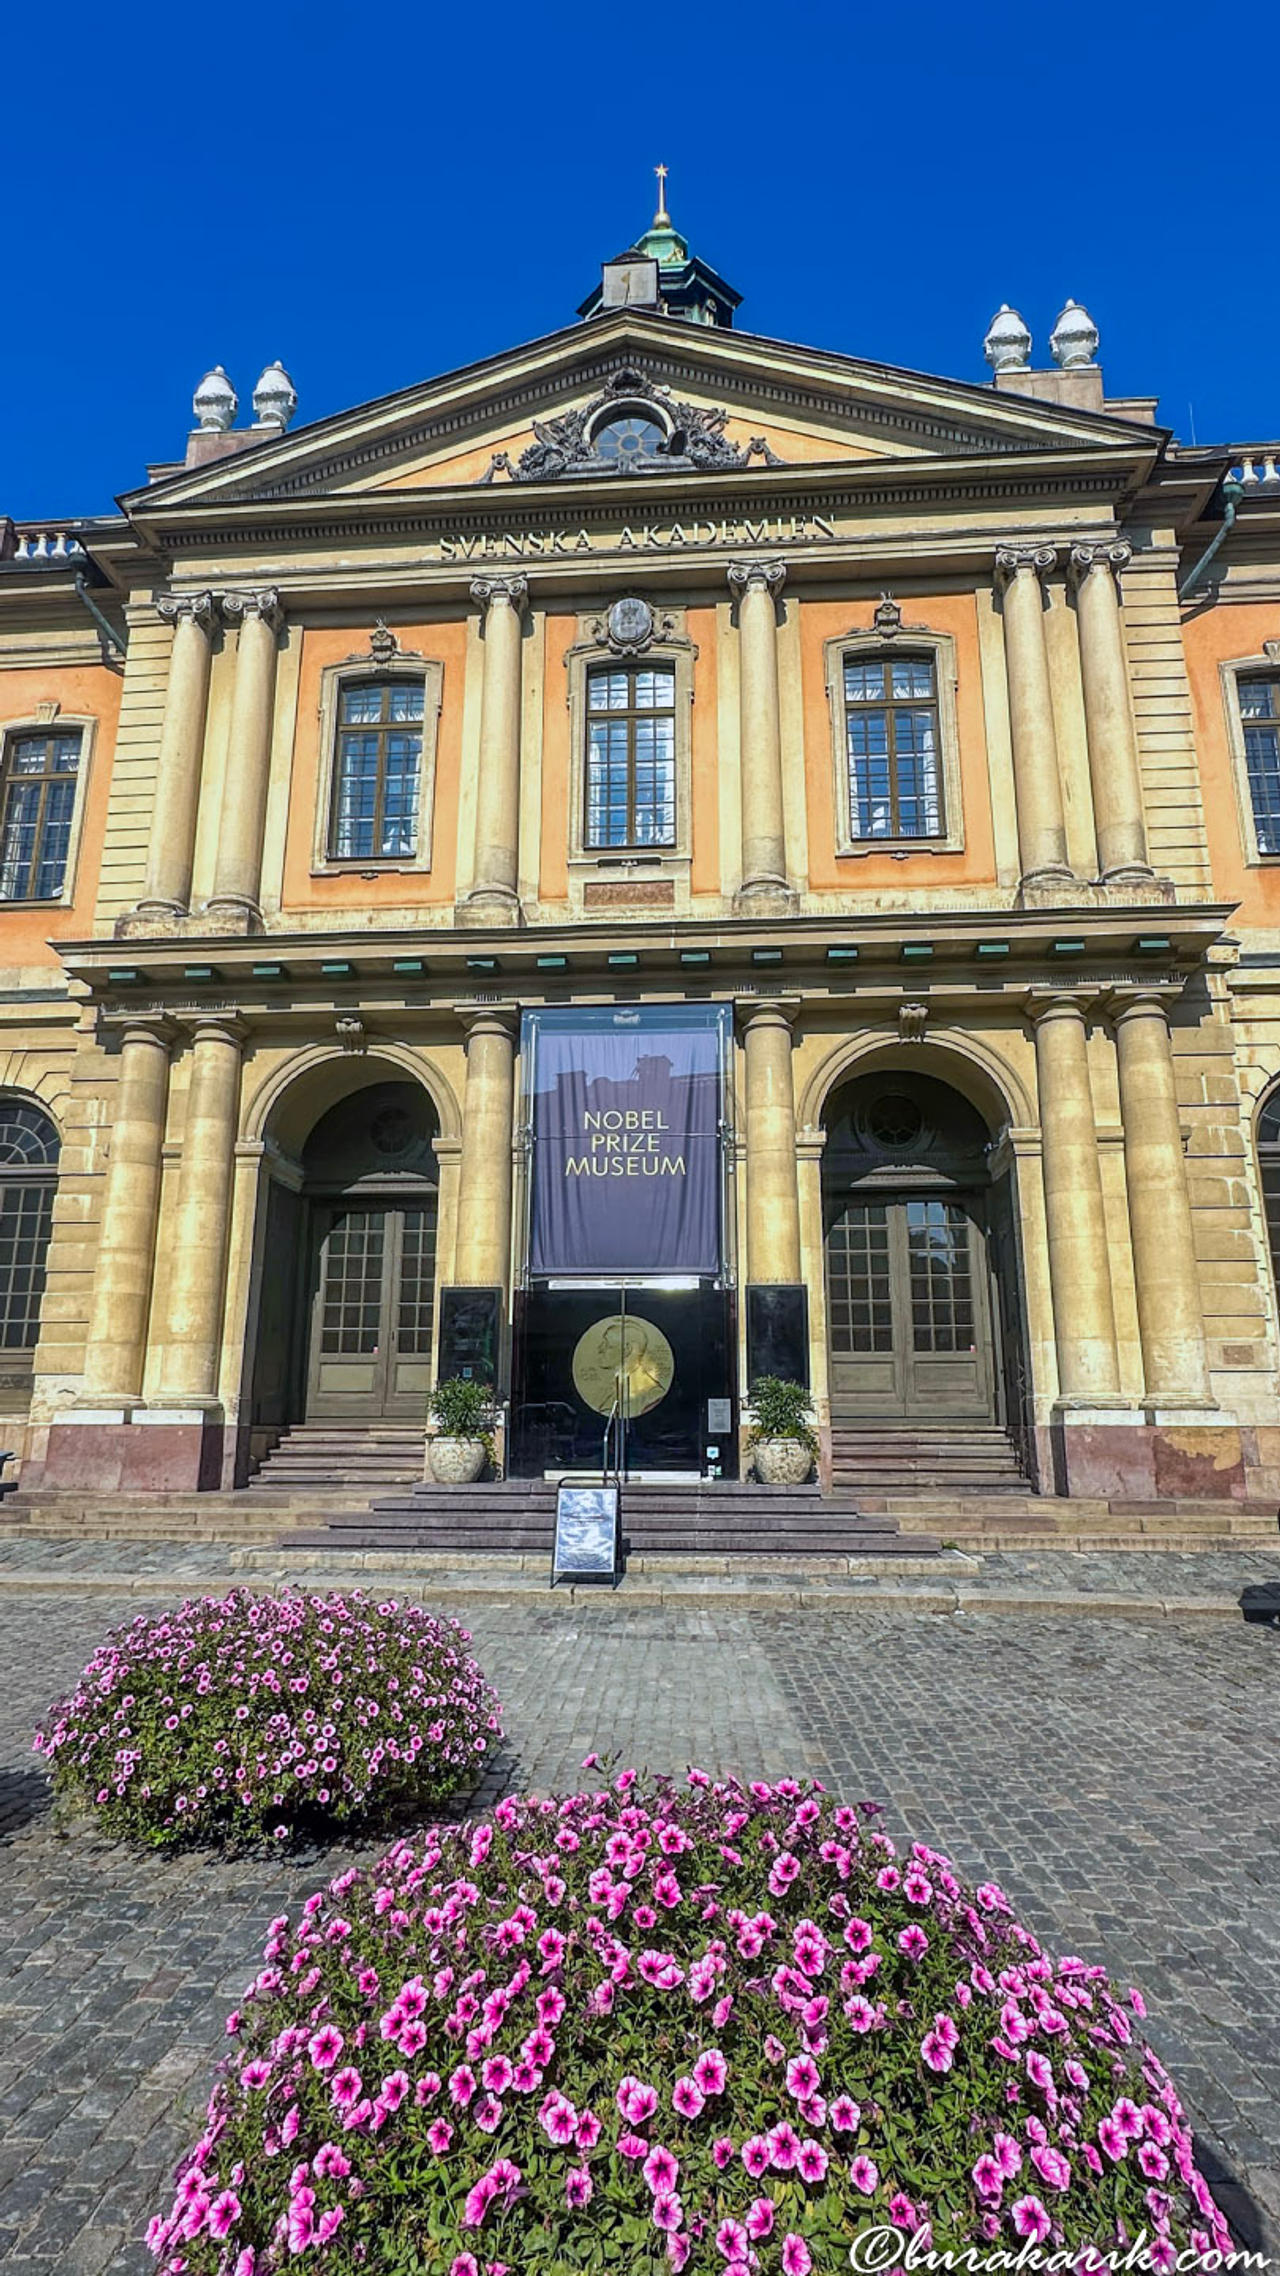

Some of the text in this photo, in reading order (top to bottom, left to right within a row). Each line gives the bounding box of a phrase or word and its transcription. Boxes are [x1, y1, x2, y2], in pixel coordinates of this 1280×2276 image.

[439, 513, 836, 561] SVENSKA AKADEMIEN
[583, 1110, 670, 1131] NOBEL
[591, 1132, 661, 1153] PRIZE
[564, 1155, 687, 1177] MUSEUM
